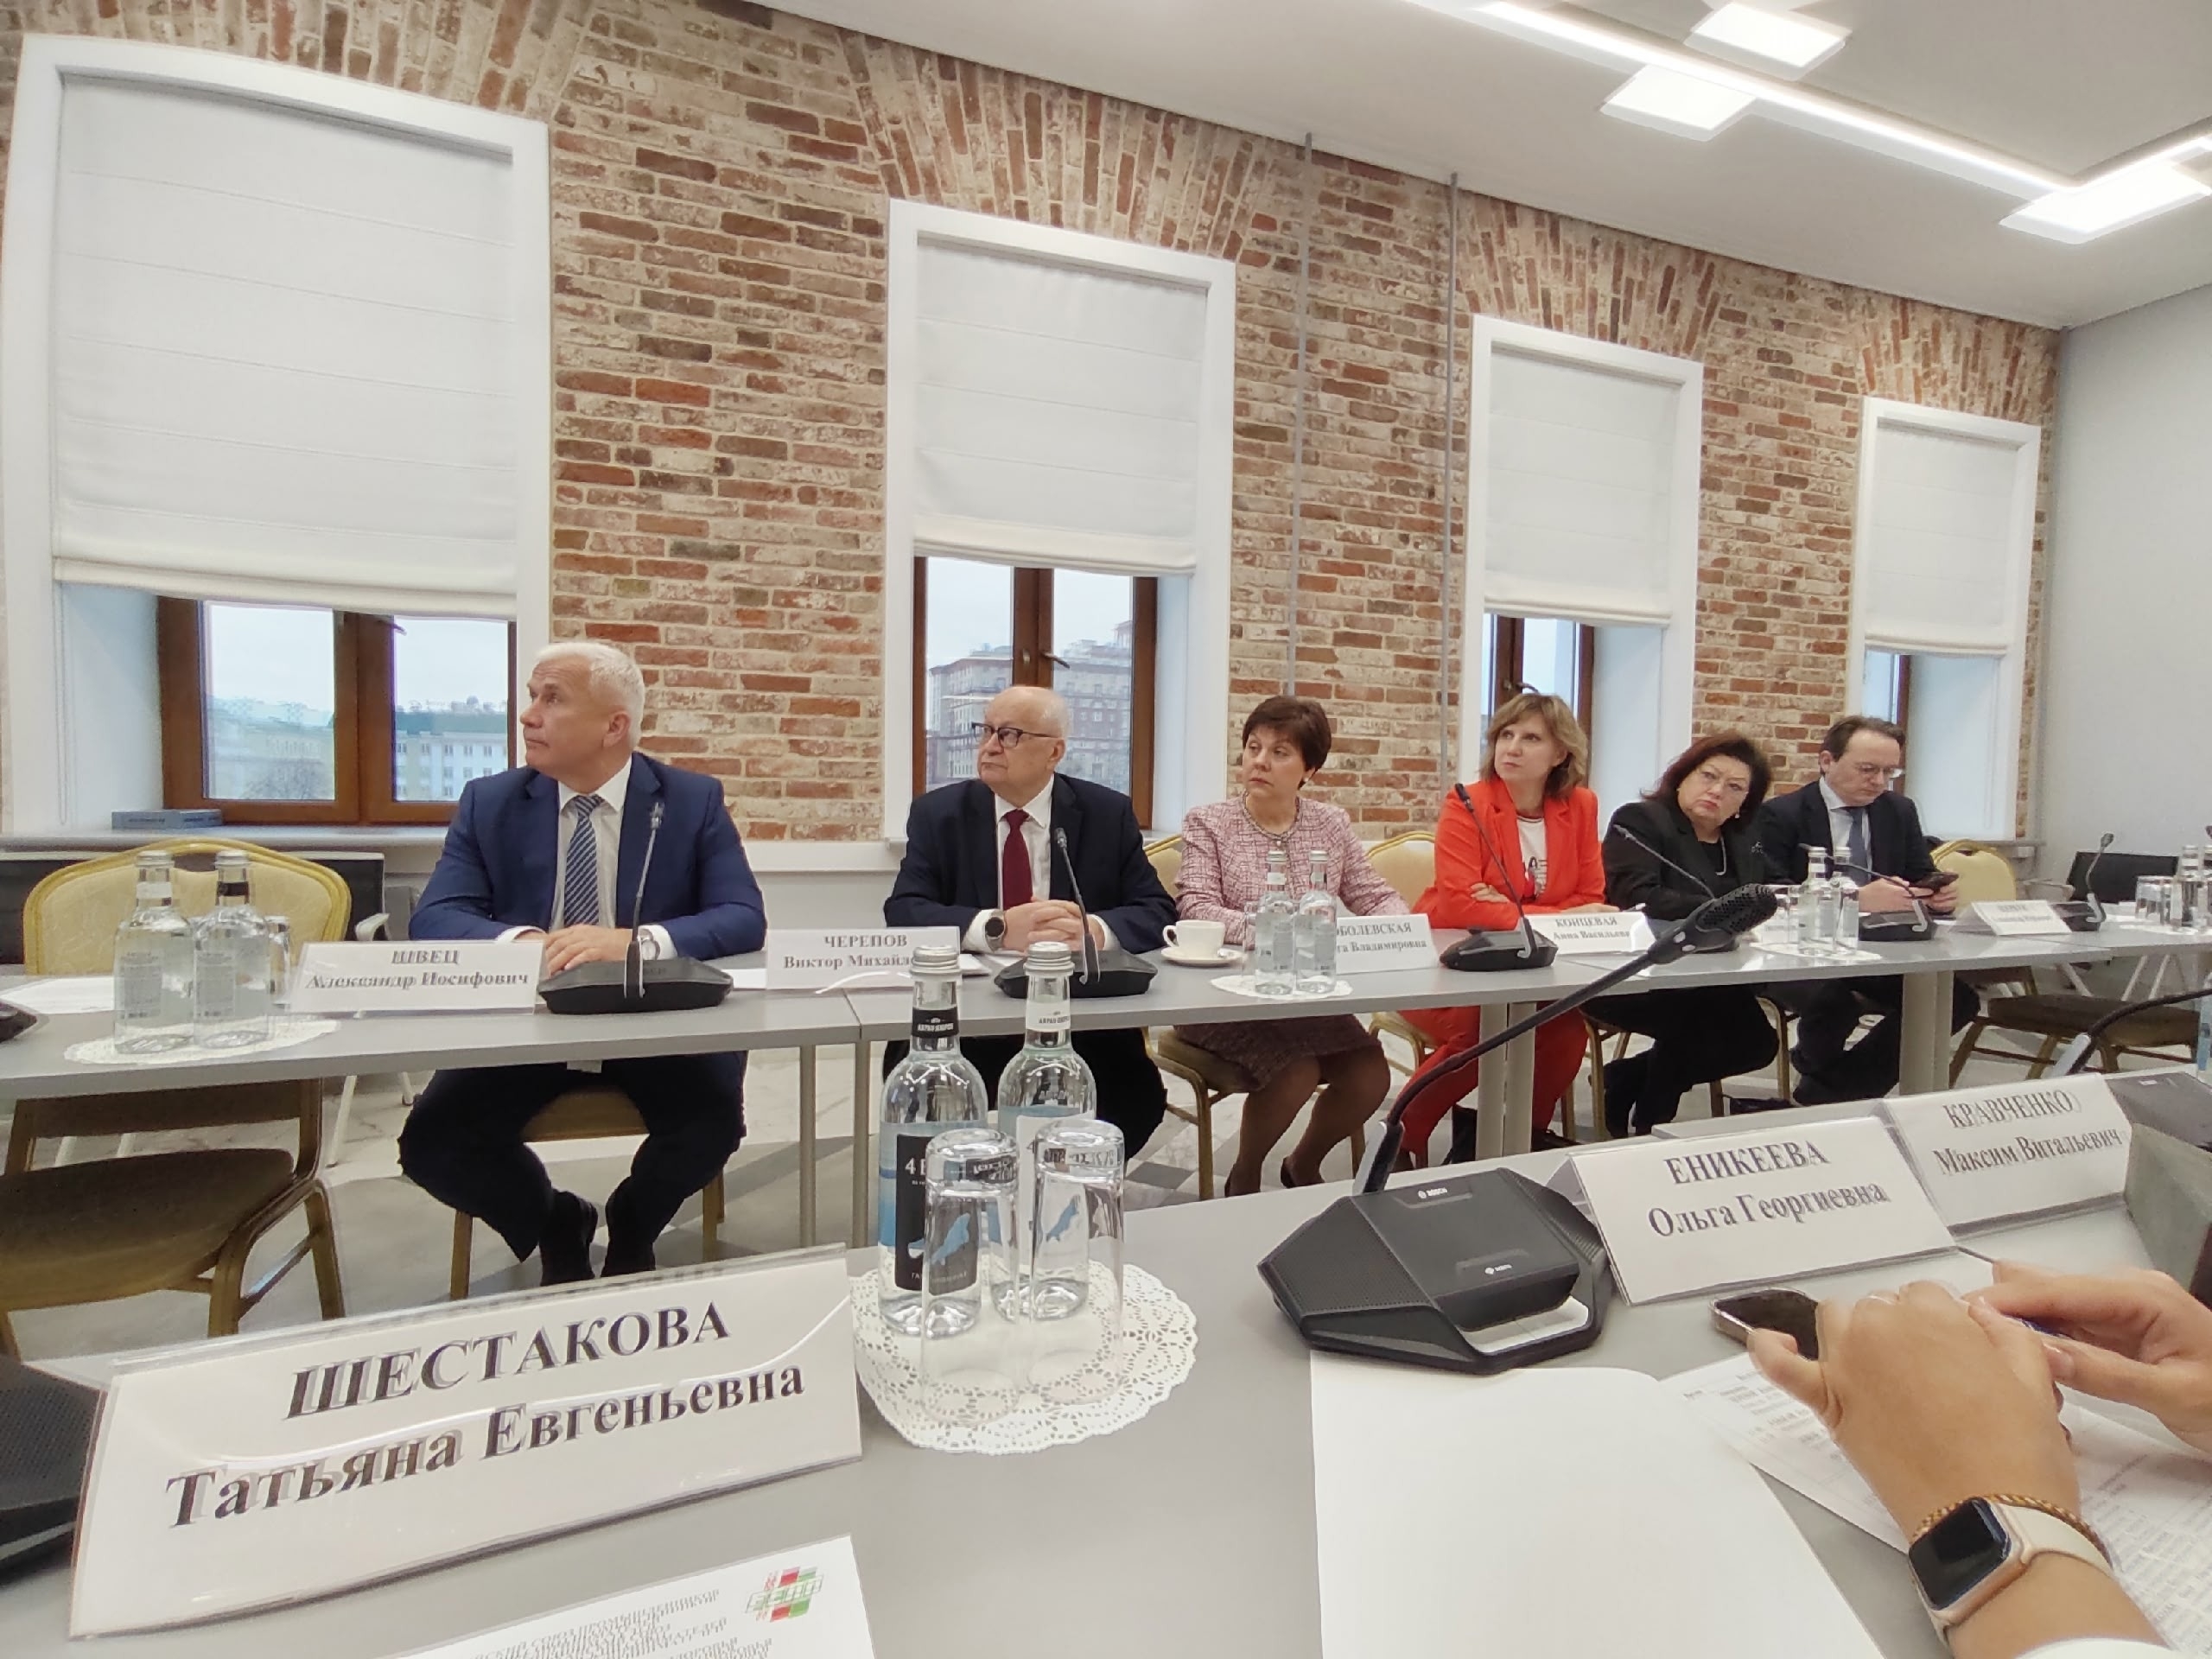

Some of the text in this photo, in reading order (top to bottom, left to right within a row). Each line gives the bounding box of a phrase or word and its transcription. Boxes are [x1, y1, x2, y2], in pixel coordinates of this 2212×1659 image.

[391, 950, 460, 965] ШВЕЦ
[824, 934, 907, 948] ЧЕРЕПОВ
[421, 971, 529, 987] Иосифович
[784, 956, 843, 970] Виктор
[1942, 1089, 2074, 1128] КРАВЧЕНКО
[1663, 1141, 1831, 1185] ЕНИКЕЕВА
[1932, 1128, 2123, 1175] Максим Витальевич
[1648, 1183, 1891, 1237] Ольга Георгиевна
[282, 1300, 731, 1420] ШЕСТАКОВА
[165, 1363, 807, 1528] Татьяна Евгеньевна
